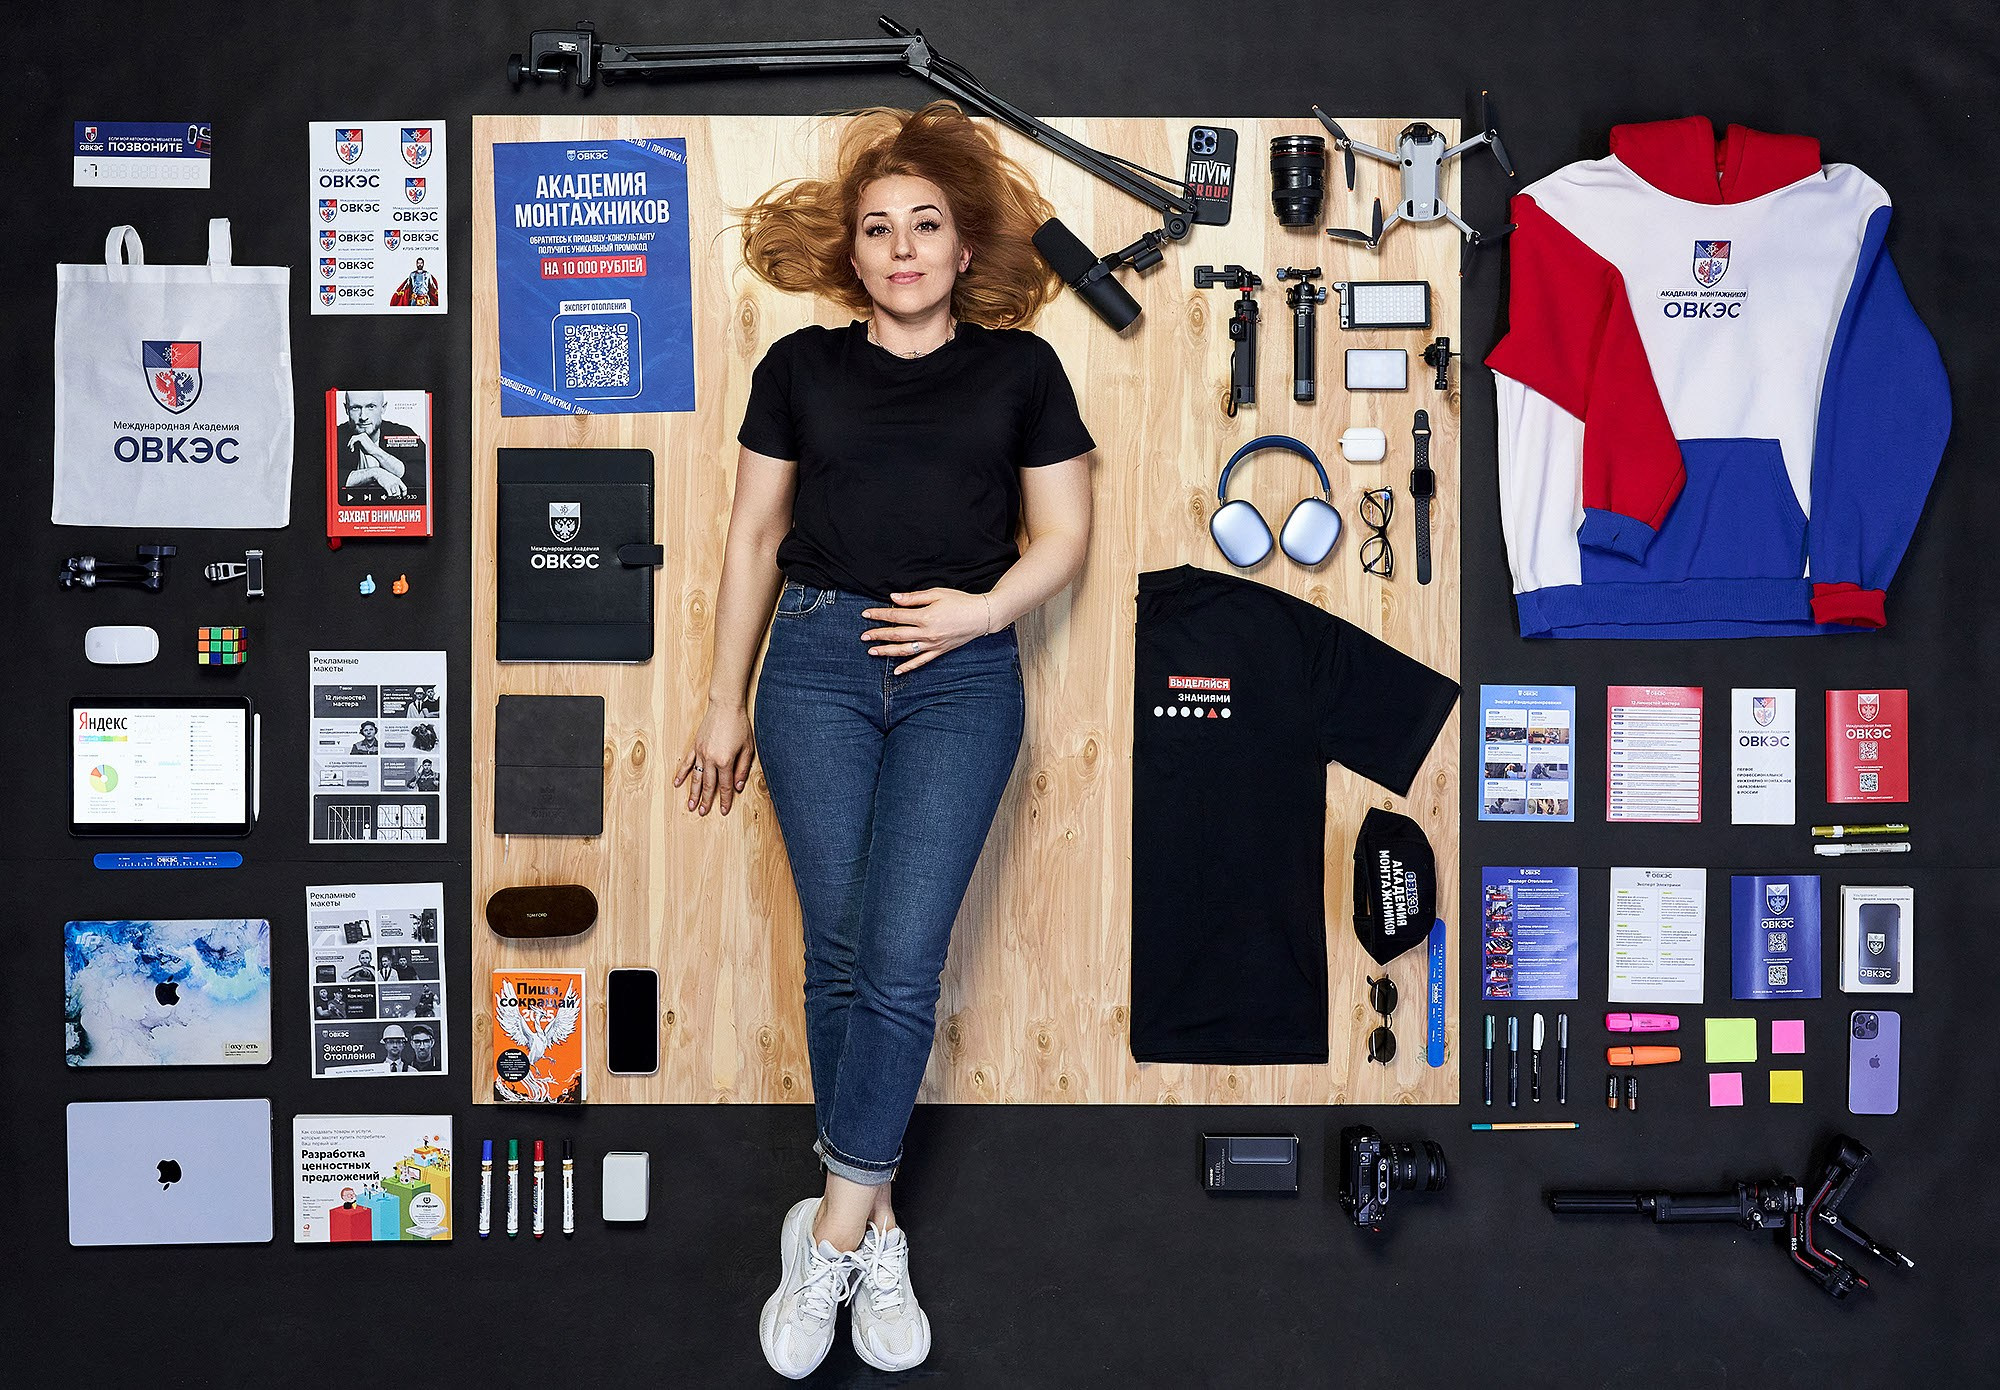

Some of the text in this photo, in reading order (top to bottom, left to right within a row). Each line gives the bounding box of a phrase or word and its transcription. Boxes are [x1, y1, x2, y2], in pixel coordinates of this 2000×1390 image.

[108, 142, 183, 153] ПОЗВОНИТЕ
[651, 143, 682, 163] ПРАКТИКА
[577, 152, 608, 160] ОВКЭС
[1189, 161, 1231, 186] RUVIM
[319, 175, 380, 188] ОВКЭС
[535, 172, 647, 200] АКАДЕМИЯ
[340, 203, 380, 212] ОВКЭС
[393, 211, 438, 222] ОВКЭС
[515, 200, 670, 228] МОНТАЖНИКОВ
[338, 234, 374, 242] ОВКЭС
[403, 233, 439, 242] ОВКЭС
[529, 232, 655, 245] ОБРАТИТЕСЬ К ПРОДАВЦУ-КОНСУЛЬТАНТУ
[538, 243, 647, 254] ПОЛУЧИТЕ УНИКАЛЬНЫЙ ПРОМОКОД
[338, 261, 374, 270] ОВКЭС
[544, 257, 643, 275] НА 10 000 РУБЛЕЙ
[338, 289, 374, 297] ОВКЭС
[1660, 290, 1697, 298] АКАДЕМИЯ
[564, 302, 627, 312] ЭКСПЕРТ ОТОПЛЕНИЯ
[1664, 302, 1741, 318] ОВКЭС
[541, 392, 571, 411] ПРАКТИКА
[113, 421, 239, 432] Международная Академия
[113, 436, 240, 464] ОВКЭС
[338, 510, 421, 523] ЗАХВАТ ВНИМАНИЯ
[531, 554, 600, 569] ОВКЭС
[313, 657, 359, 665] Рекламные
[1170, 678, 1229, 689] ВЫДЕЛЯЙСЯ
[1178, 693, 1231, 703] ЗНАНИЯМИ
[79, 712, 128, 732] Яндекс
[1845, 728, 1892, 739] ОВКЭС
[1739, 736, 1790, 747] ОВКЭС
[310, 891, 357, 900] Рекламные
[1379, 850, 1396, 936] МОНТАЖНИКОВ
[1392, 860, 1408, 927] АКАДЕМИЯ
[1404, 871, 1419, 915] ОВКЭС
[1761, 920, 1794, 929] ОВКЭС
[1860, 969, 1891, 979] ОВКЭС
[517, 983, 563, 997] Пиши,
[499, 995, 576, 1010] сокращай
[324, 1052, 376, 1061] Отопления
[301, 1149, 365, 1161] Разработка
[302, 1162, 371, 1172] ценностных
[302, 1171, 380, 1184] предложений
